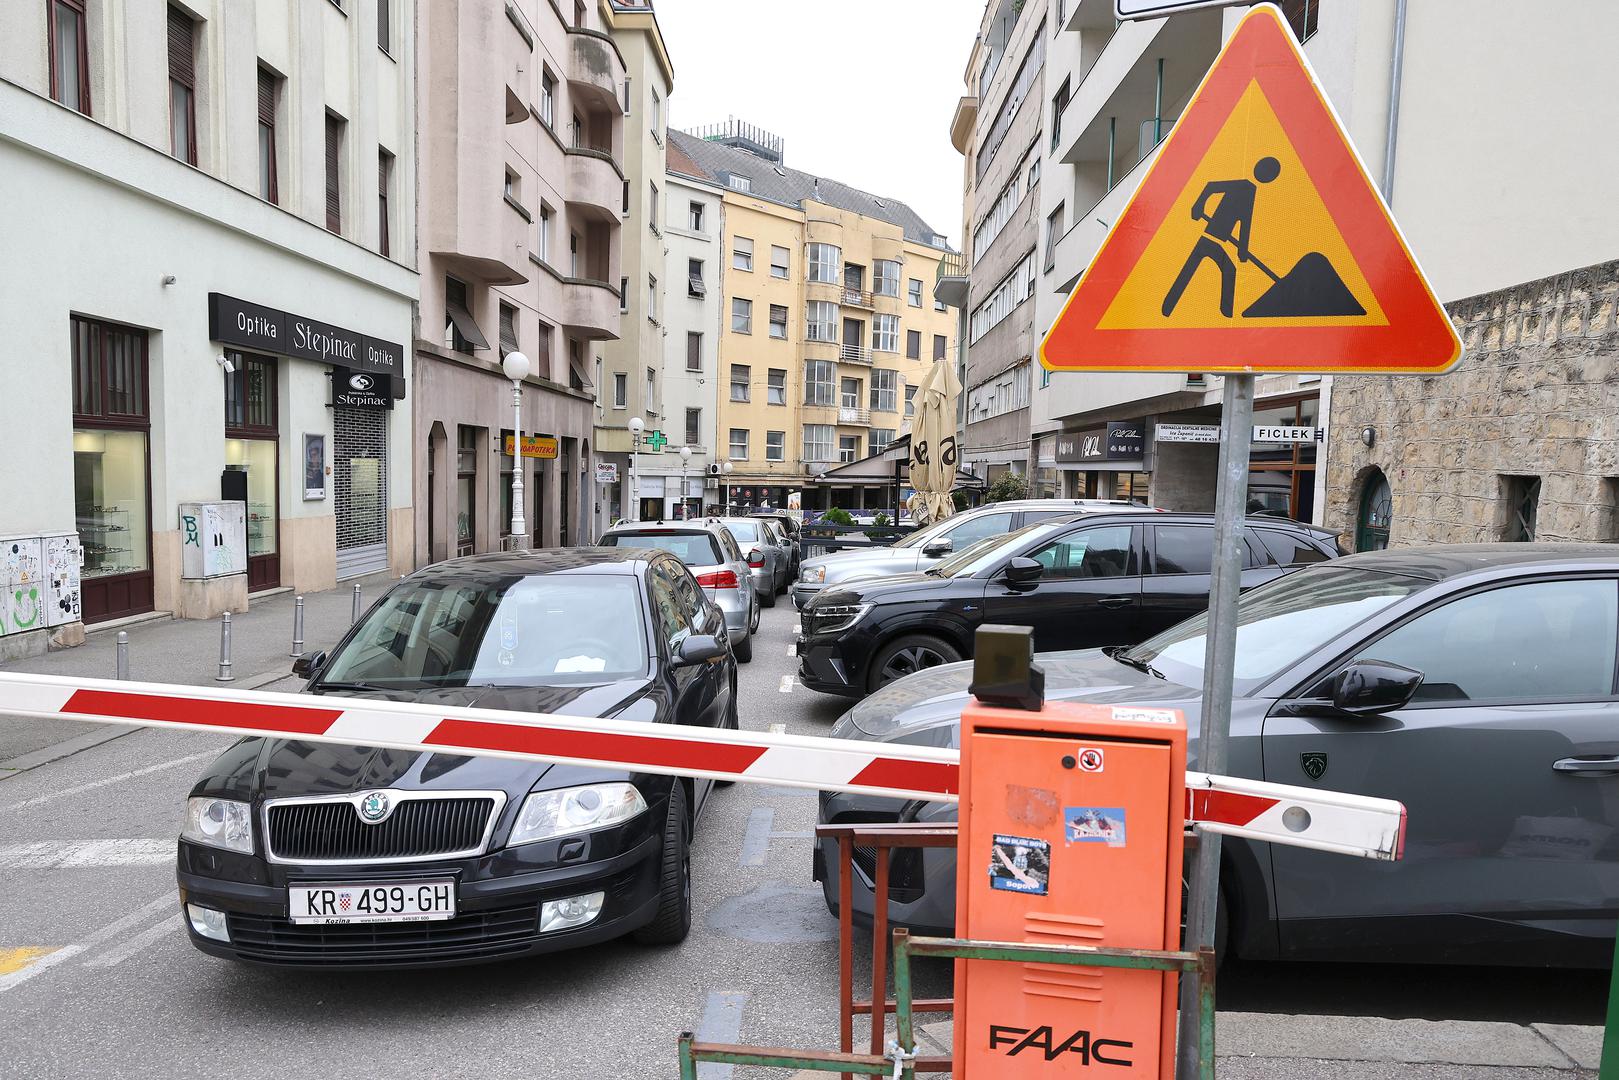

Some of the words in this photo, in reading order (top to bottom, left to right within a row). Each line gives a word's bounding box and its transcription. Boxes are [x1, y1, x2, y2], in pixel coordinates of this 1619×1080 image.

[237, 312, 277, 338] Optika
[293, 322, 357, 361] Stepinac
[368, 346, 393, 366] Optika
[336, 395, 387, 406] Stepinac
[1259, 429, 1309, 439] FICLEK
[996, 836, 1011, 844] BAD
[1011, 838, 1029, 846] BLUE
[1029, 840, 1047, 849] BOYS
[307, 890, 337, 915] KR
[357, 885, 449, 914] 499-GH
[989, 1024, 1134, 1067] FAAC
